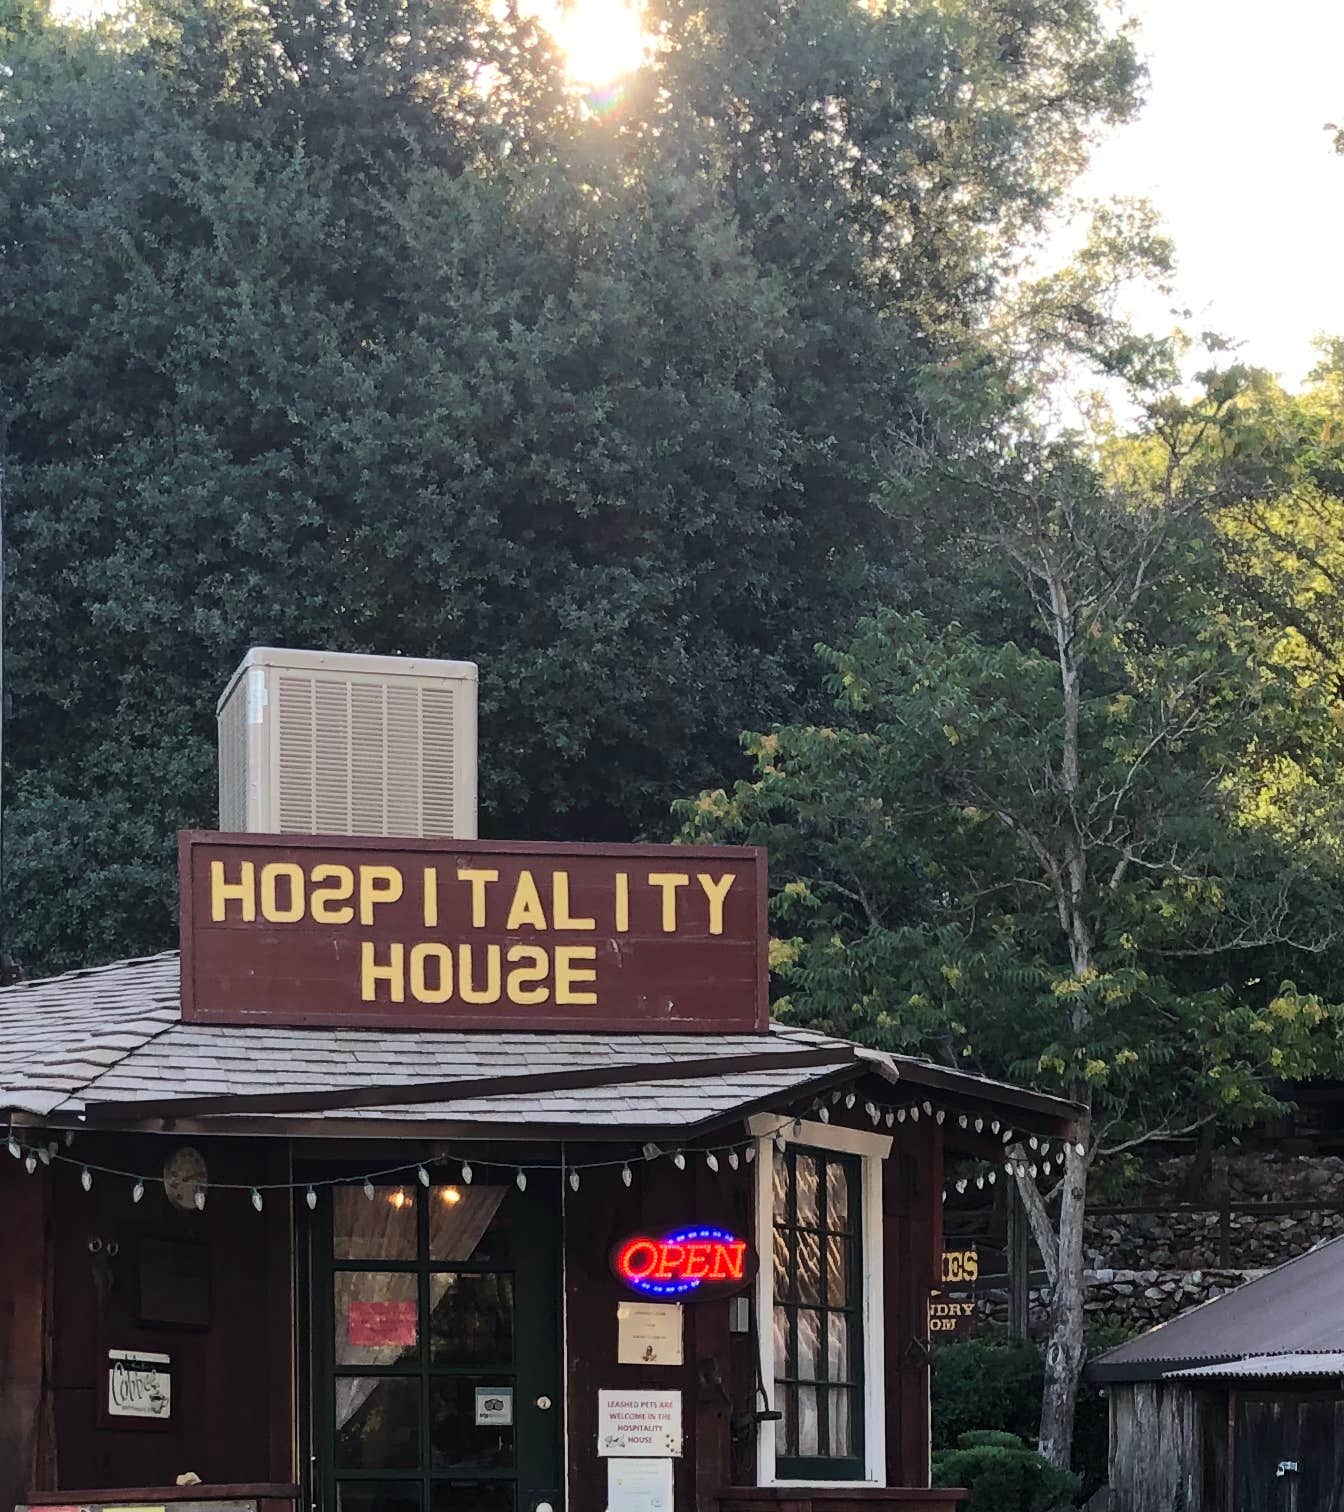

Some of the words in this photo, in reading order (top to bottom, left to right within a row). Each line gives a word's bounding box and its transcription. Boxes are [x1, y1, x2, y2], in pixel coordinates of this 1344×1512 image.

[210, 860, 737, 935] HOSPITALITY
[361, 941, 598, 1005] HOUSE
[619, 1239, 747, 1279] OPEN
[607, 1401, 638, 1409] LEASHED
[640, 1401, 657, 1409] PETS
[659, 1401, 673, 1409] ARE
[609, 1413, 645, 1421] WELCOME
[647, 1413, 656, 1421] IN
[657, 1413, 671, 1421] THE
[617, 1425, 663, 1433] HOSPITALITY
[627, 1436, 653, 1444] HOUSE
